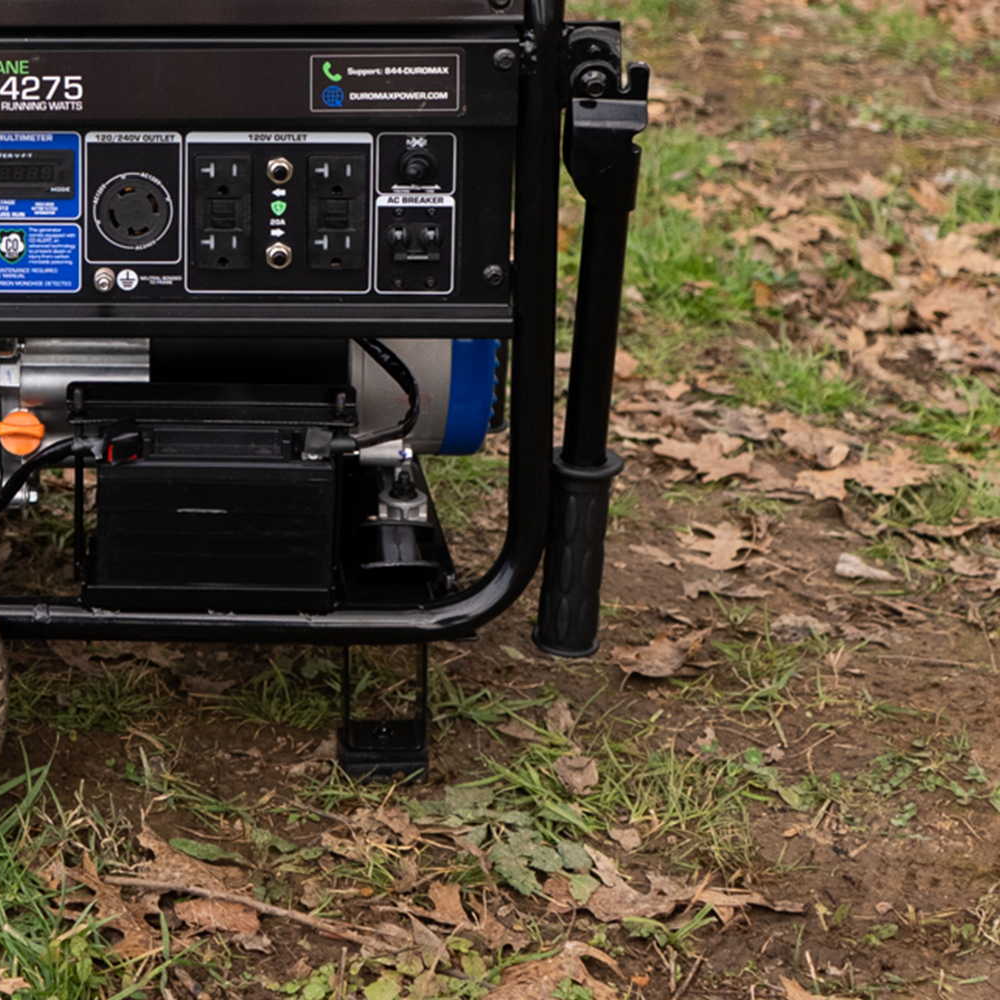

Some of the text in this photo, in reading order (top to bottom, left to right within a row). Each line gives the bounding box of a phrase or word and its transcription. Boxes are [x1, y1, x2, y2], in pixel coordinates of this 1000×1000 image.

[347, 67, 382, 76] Support:
[0, 76, 83, 100] 4275
[349, 92, 448, 100] DUROMAXPOWER.COM
[1, 102, 82, 111] RUNNING WATTS
[95, 134, 175, 142] 120/240V OUTLET
[270, 218, 286, 226] 20A
[6, 238, 19, 251] CO
